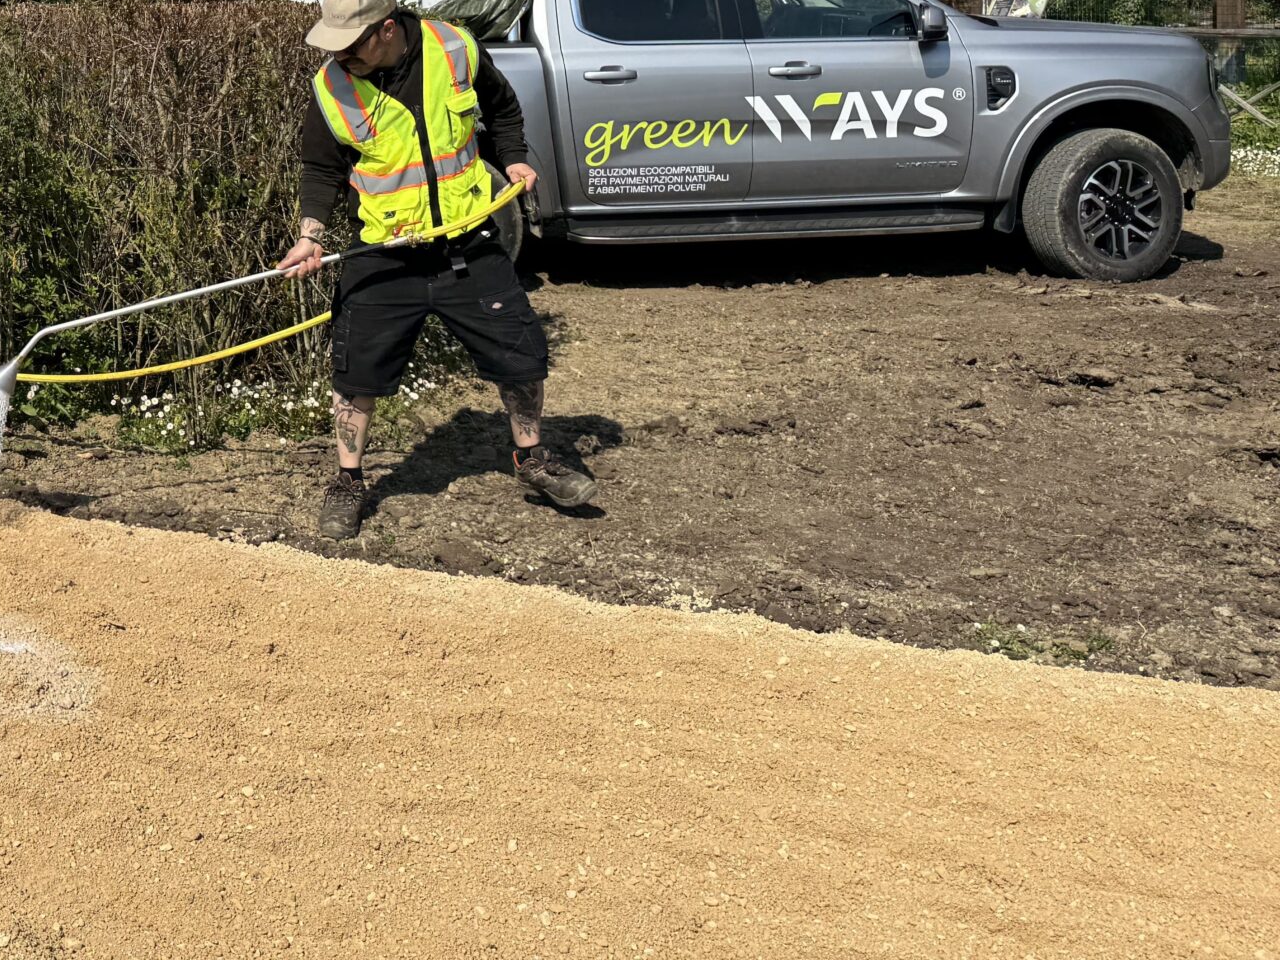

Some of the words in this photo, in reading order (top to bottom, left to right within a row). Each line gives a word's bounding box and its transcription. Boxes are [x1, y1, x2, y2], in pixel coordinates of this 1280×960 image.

[583, 117, 749, 167] green
[588, 168, 637, 177] SOLUZIONI
[640, 165, 715, 175] ECOCOMPATIBILI
[588, 178, 607, 186] PER
[609, 175, 684, 185] PAVIMENTAZIONI
[685, 174, 730, 183] NATURALI
[588, 187, 595, 195] E
[596, 184, 666, 194] ABBATTIMENTO
[667, 183, 706, 192] POLVERI
